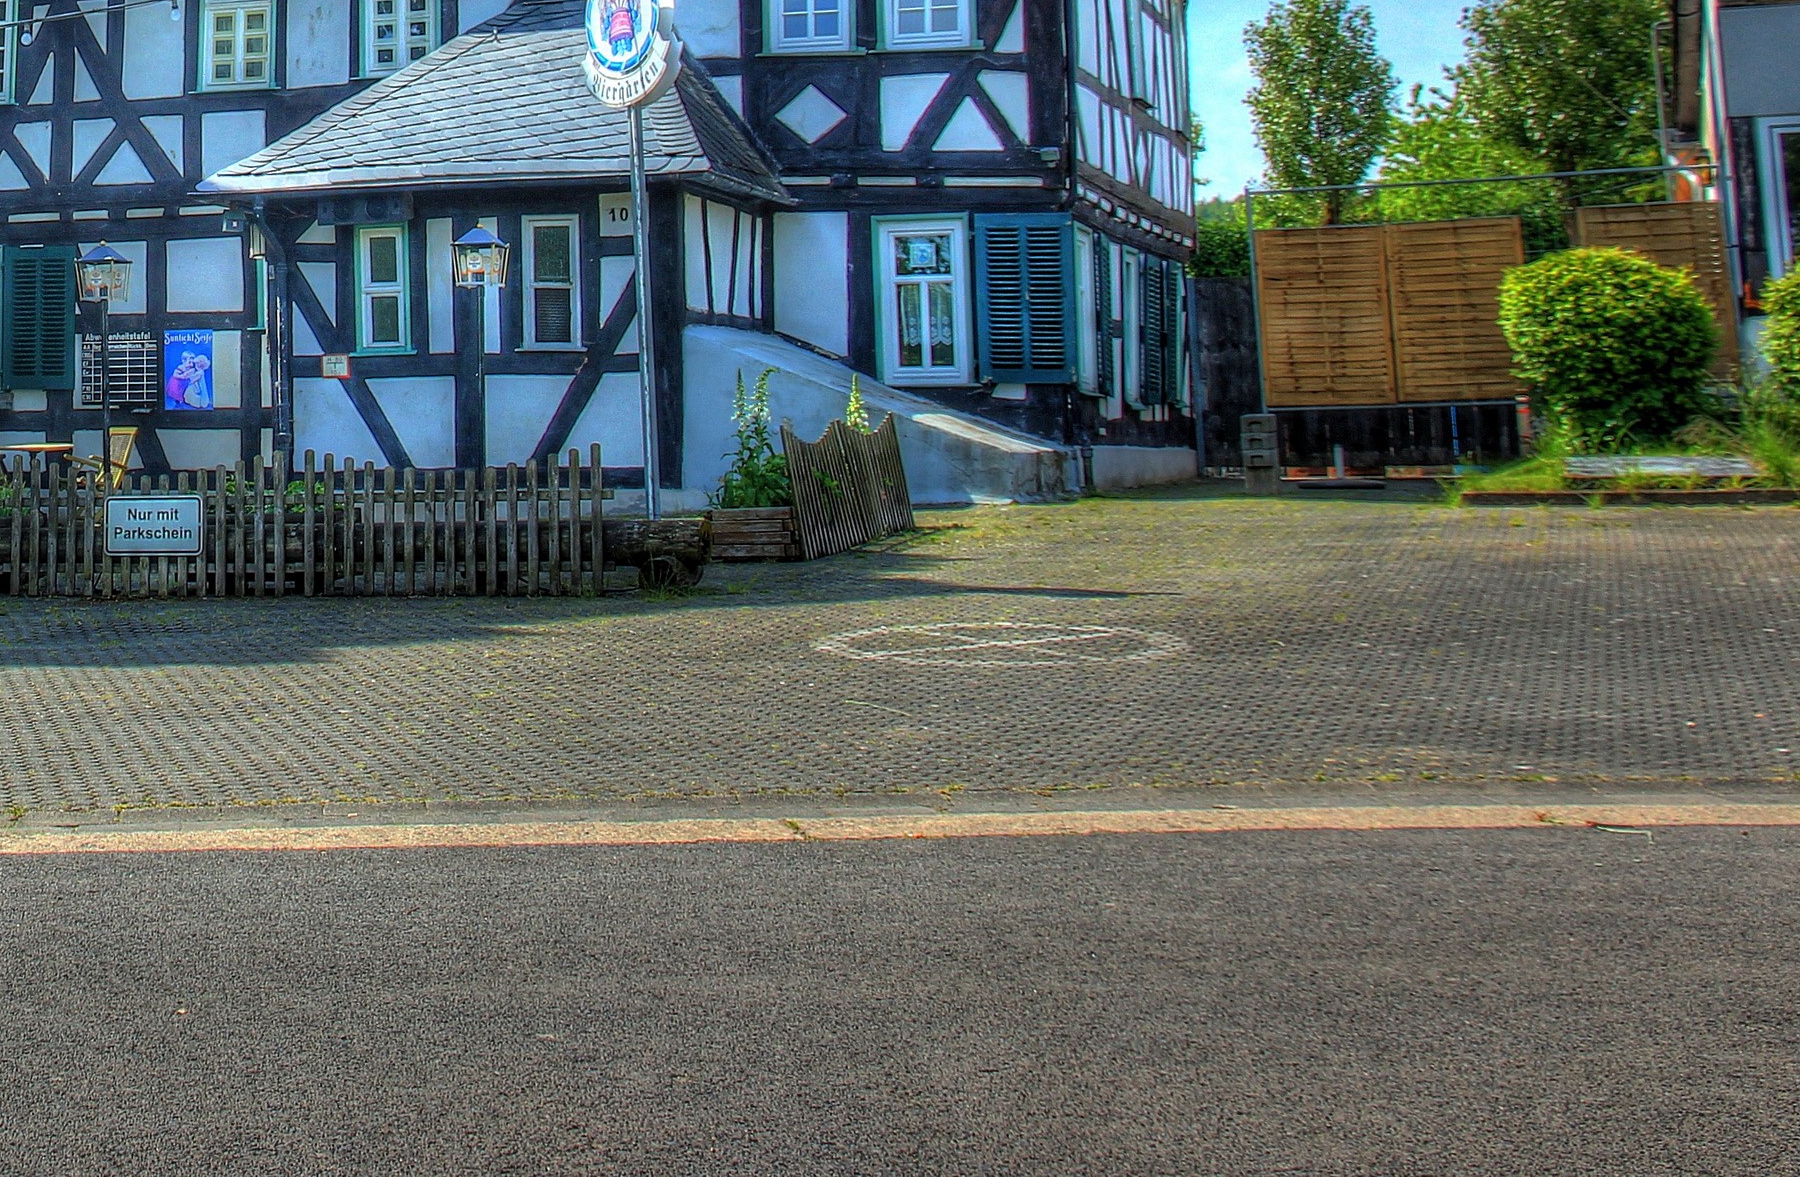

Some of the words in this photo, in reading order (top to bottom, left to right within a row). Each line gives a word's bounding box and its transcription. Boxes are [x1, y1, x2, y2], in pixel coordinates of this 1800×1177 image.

[593, 62, 659, 105] Biergarten
[608, 207, 629, 222] 10
[127, 508, 153, 521] Nur
[157, 508, 179, 521] mit
[114, 526, 192, 539] Parkschein
